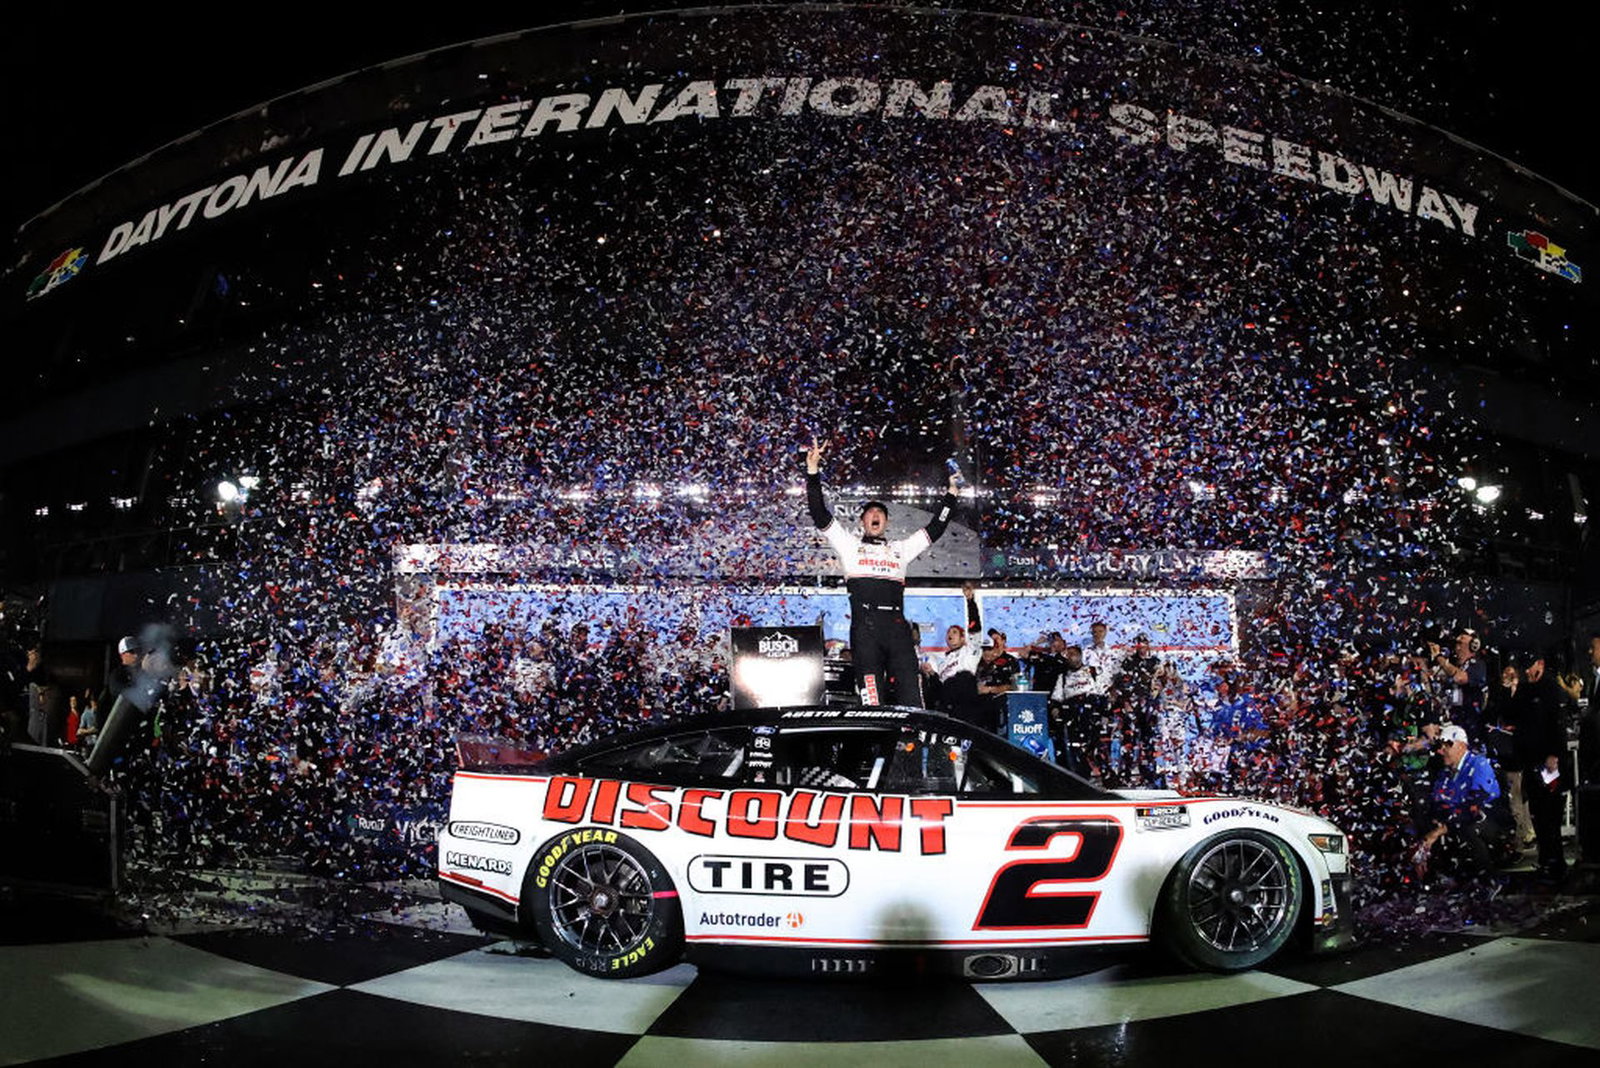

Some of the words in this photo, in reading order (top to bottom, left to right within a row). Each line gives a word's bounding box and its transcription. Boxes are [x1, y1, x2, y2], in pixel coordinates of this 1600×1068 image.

[96, 148, 324, 266] DAYTONA
[338, 76, 1076, 177] INTERNATIONAL
[1105, 103, 1479, 237] SPEEDWAY
[759, 640, 799, 653] BUSCH
[1013, 723, 1043, 735] Ruoff
[542, 776, 953, 855] DISCOUNT
[1203, 807, 1279, 825] GOODYEAR
[454, 824, 515, 841] FREIGHTLINER
[447, 851, 513, 876] MENARDS
[536, 830, 618, 888] GOODYEAR
[972, 815, 1124, 930] 2
[703, 861, 830, 891] TIRE
[700, 912, 781, 927] Autotrader
[611, 936, 655, 970] EAGLE
